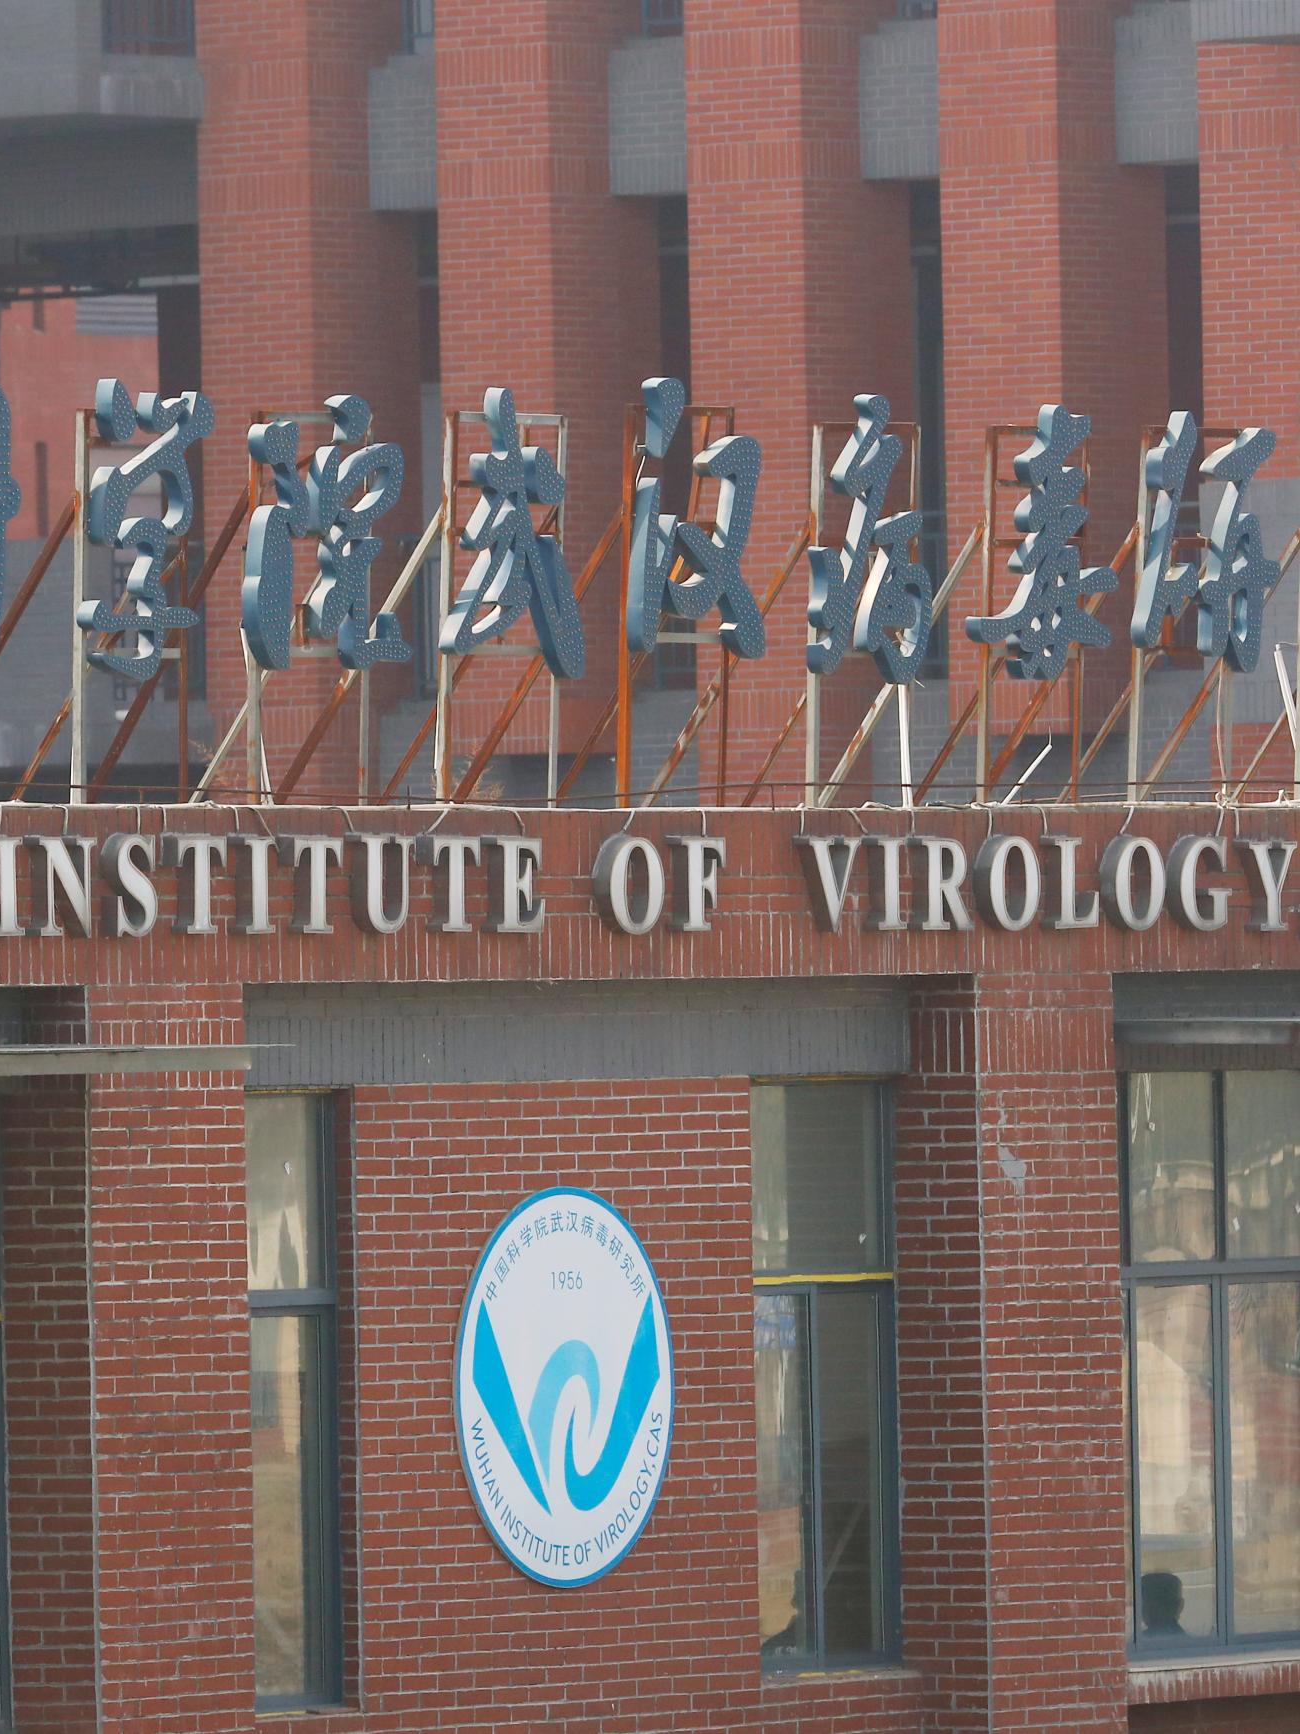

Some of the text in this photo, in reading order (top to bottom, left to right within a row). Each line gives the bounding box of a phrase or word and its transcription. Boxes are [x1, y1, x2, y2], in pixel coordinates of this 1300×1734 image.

[592, 835, 726, 936] OF
[807, 836, 1297, 935] VIROLOGY
[486, 1210, 646, 1301] 中国科学院武汉病毒研究所
[551, 1271, 583, 1290] 1956
[470, 1417, 503, 1510] WUHAN
[500, 1504, 570, 1566] INSTITUTE
[573, 1540, 592, 1565] OF
